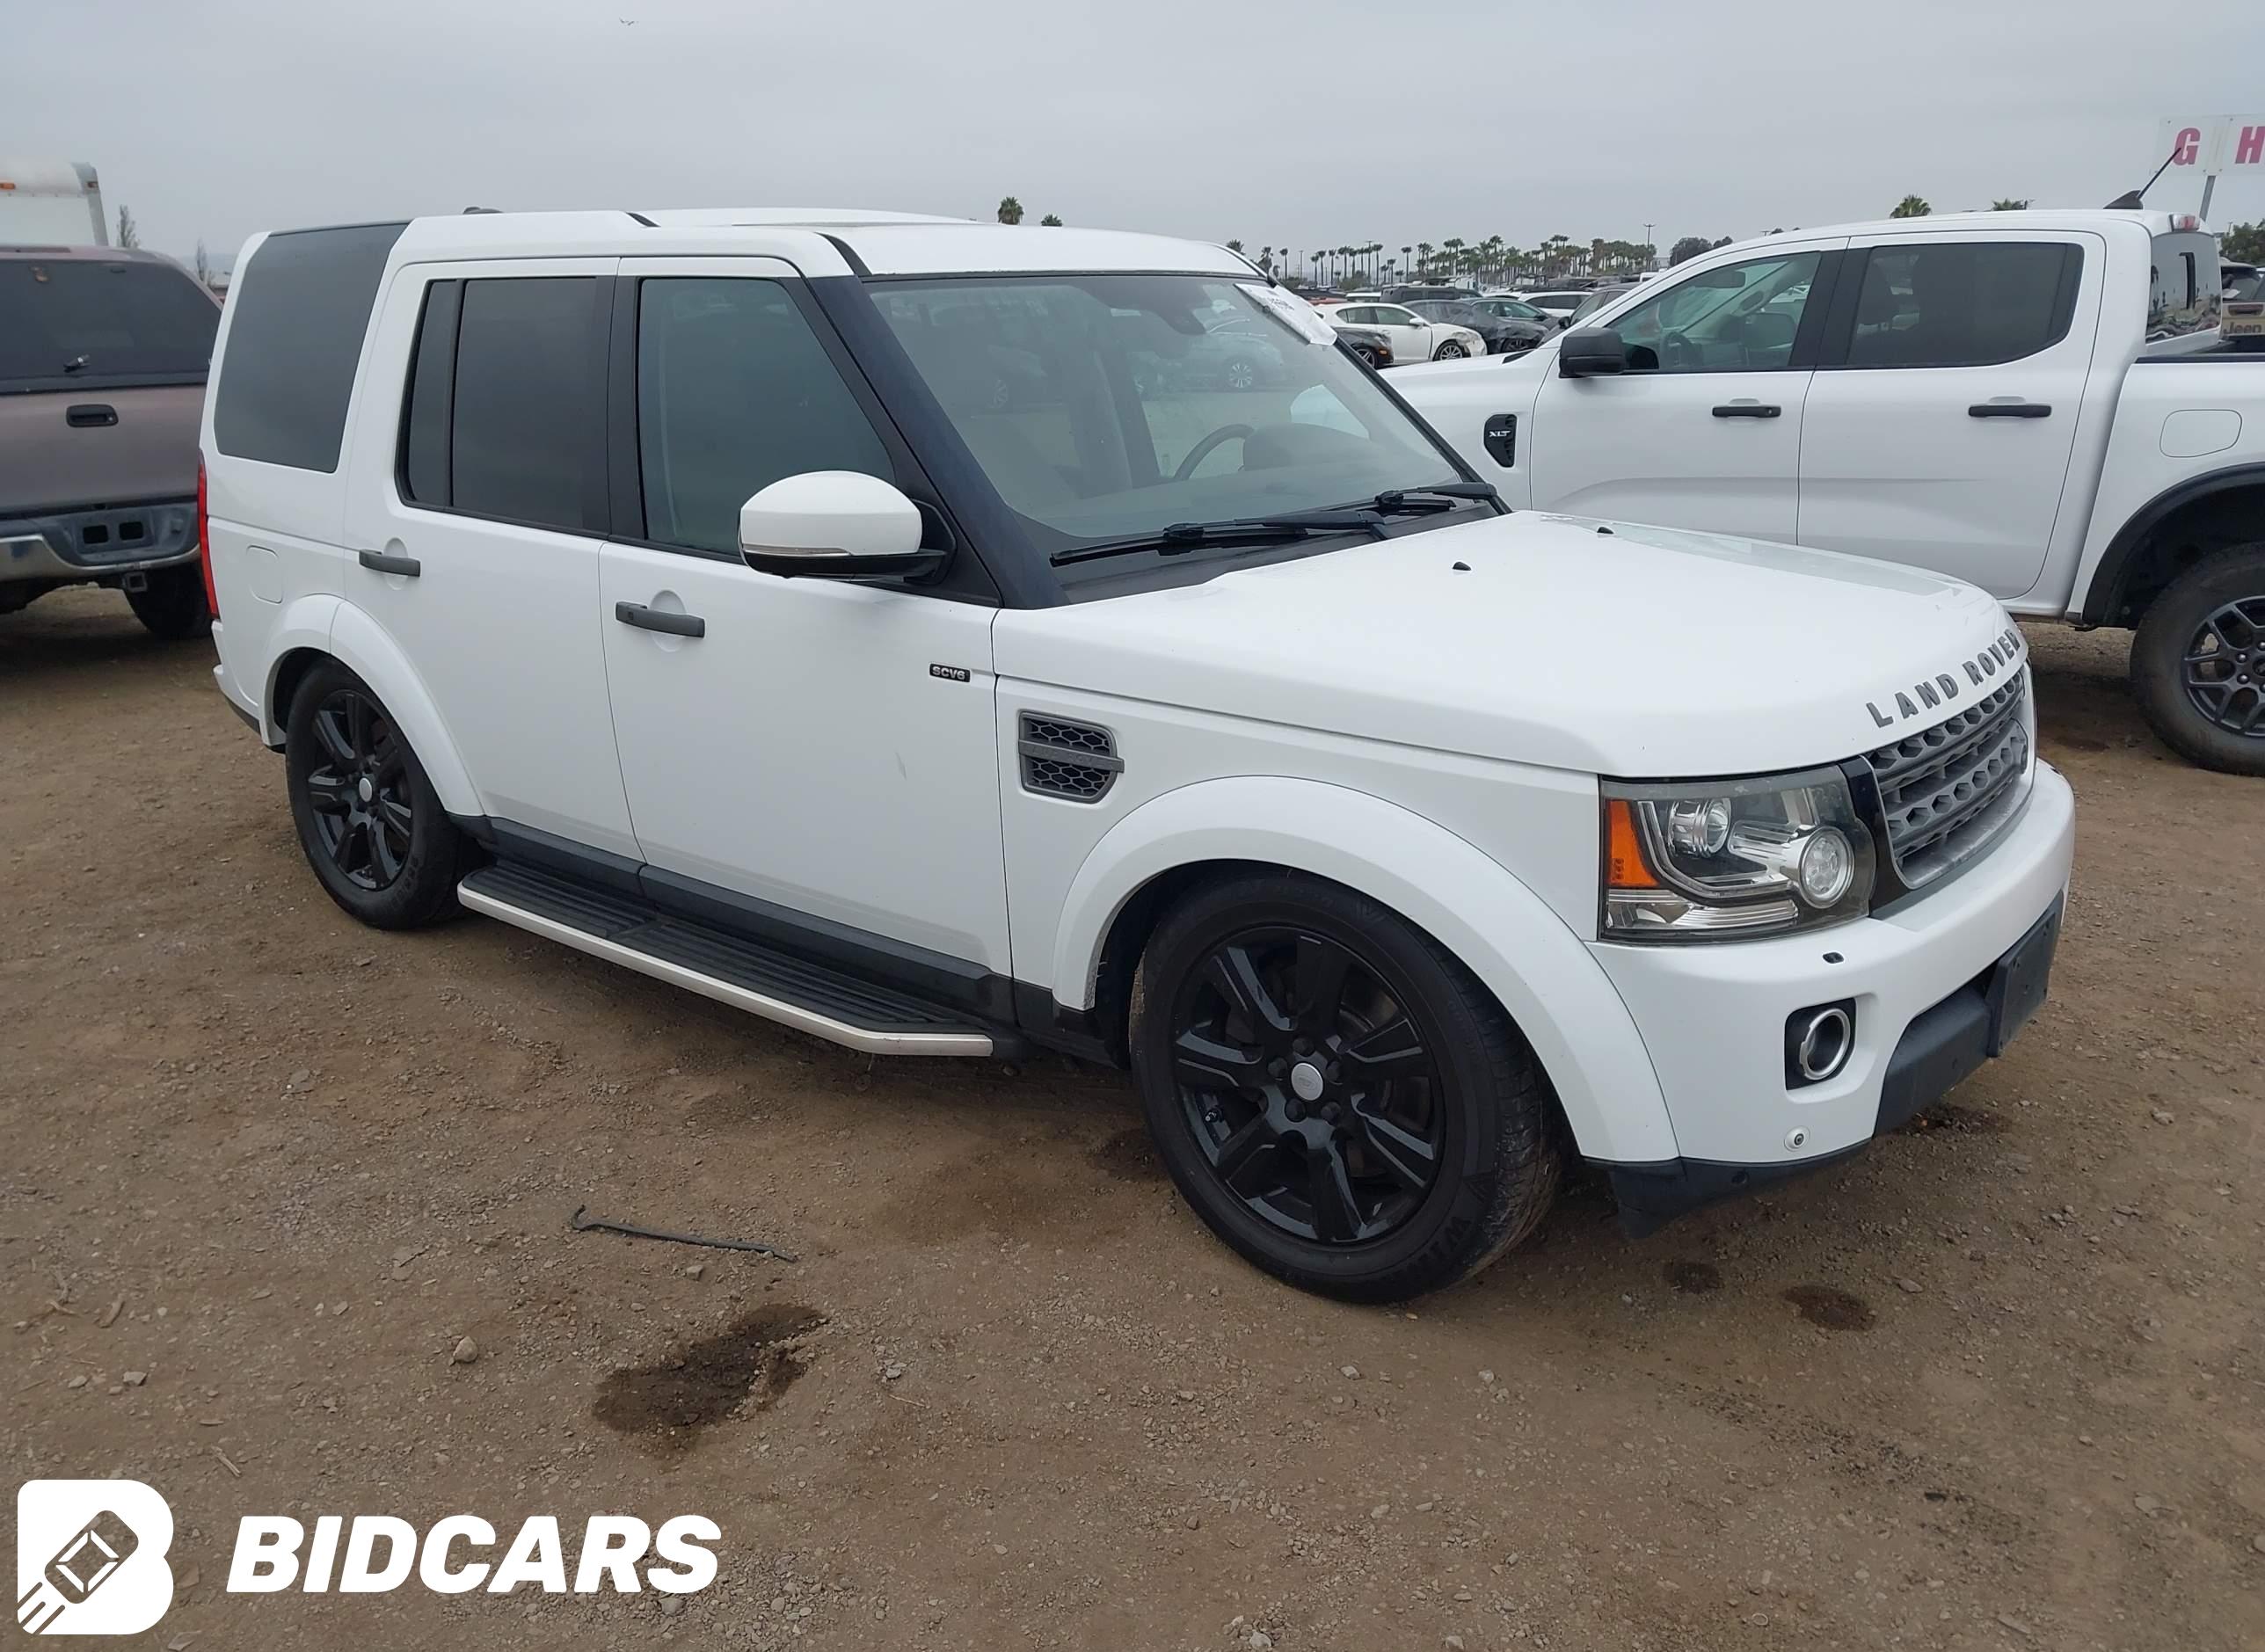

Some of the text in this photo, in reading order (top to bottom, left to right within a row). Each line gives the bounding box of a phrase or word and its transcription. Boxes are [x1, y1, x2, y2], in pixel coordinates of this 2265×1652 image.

[2172, 126, 2265, 165] G H
[932, 666, 965, 680] SCV6
[1866, 629, 2021, 728] LAND ROVER
